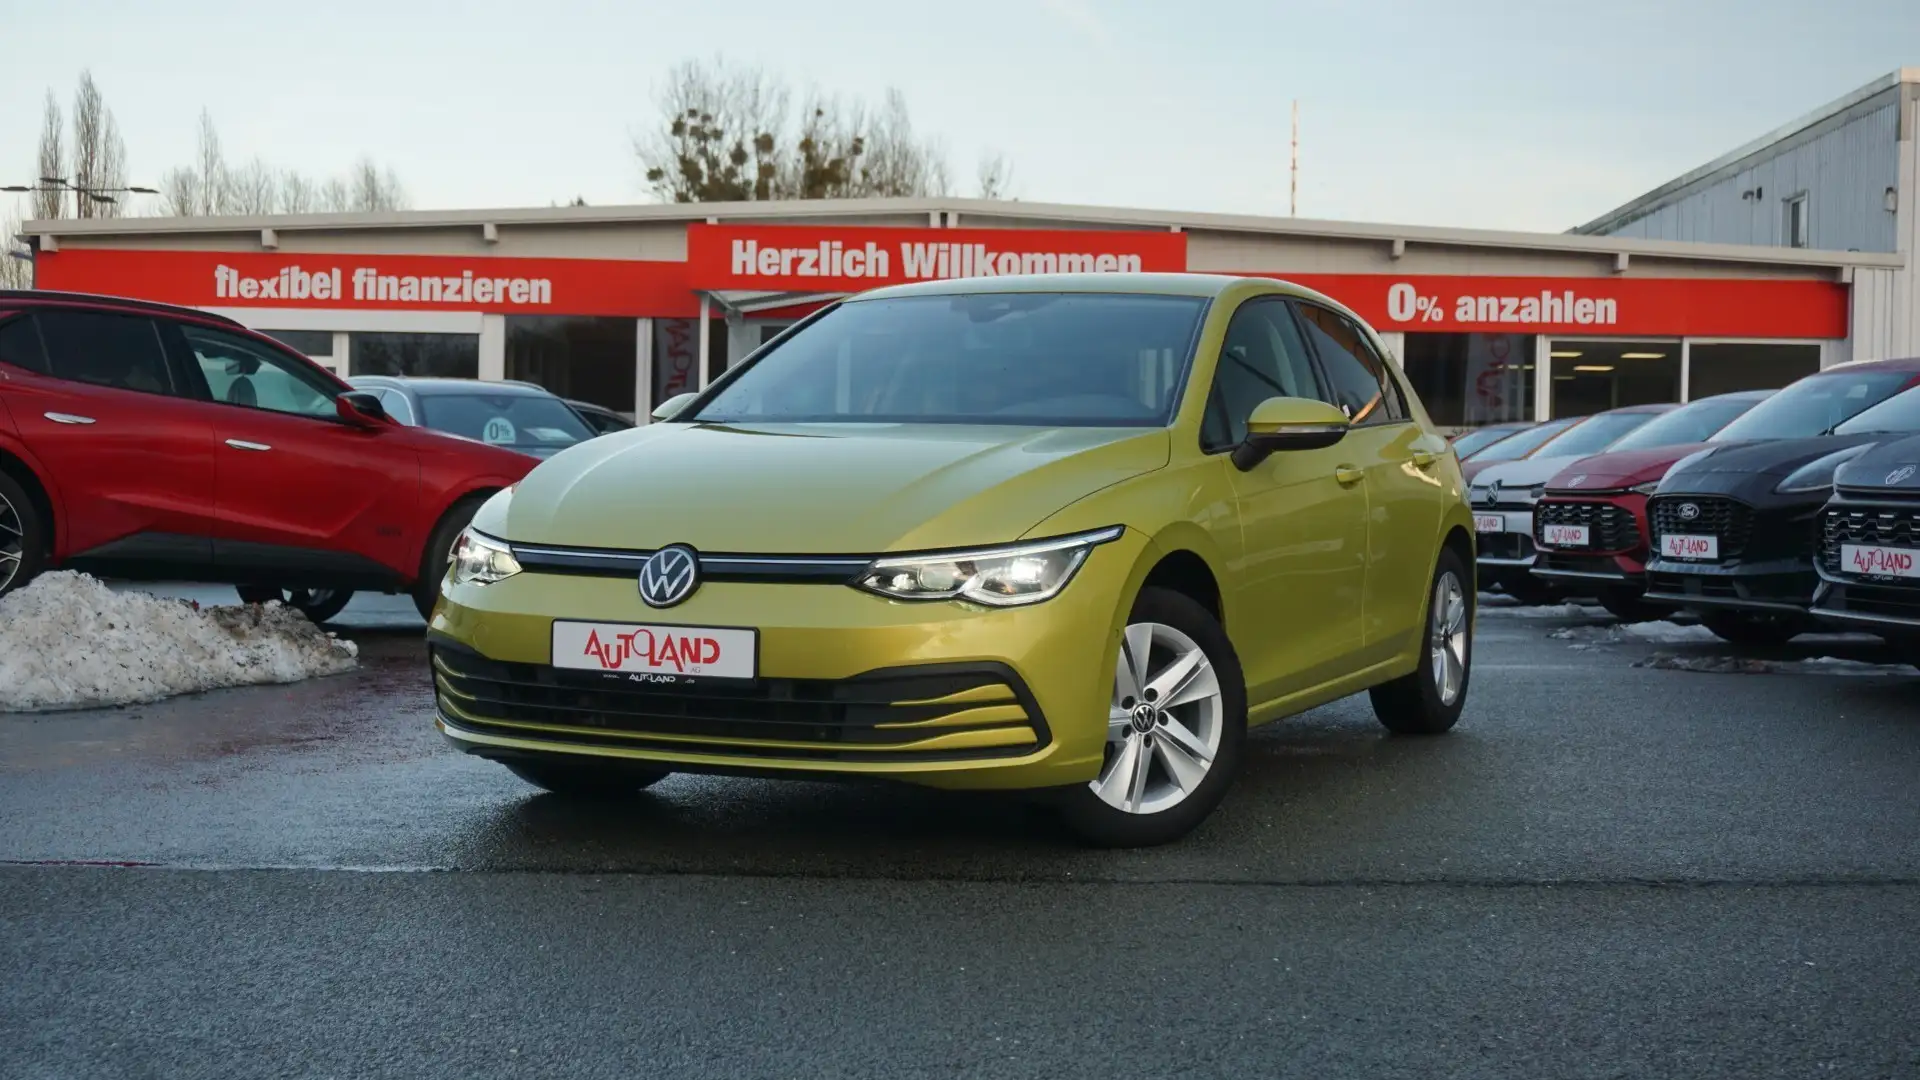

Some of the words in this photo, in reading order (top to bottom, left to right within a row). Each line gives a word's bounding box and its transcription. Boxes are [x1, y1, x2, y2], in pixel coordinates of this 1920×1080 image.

[731, 239, 889, 278] Herzlich
[901, 242, 1142, 279] Willkommen
[215, 264, 341, 300] flexibel
[352, 268, 552, 305] finanzieren
[1387, 282, 1444, 323] 0%
[1455, 290, 1617, 324] anzahlen
[488, 422, 511, 440] 0%
[1669, 536, 1709, 556] AUTOLAND
[1853, 548, 1912, 575] AUTOLAND
[643, 547, 696, 602] VW
[584, 628, 720, 672] AUTOLAND
[628, 673, 676, 684] AUTOLAND
[1134, 706, 1155, 731] VW
